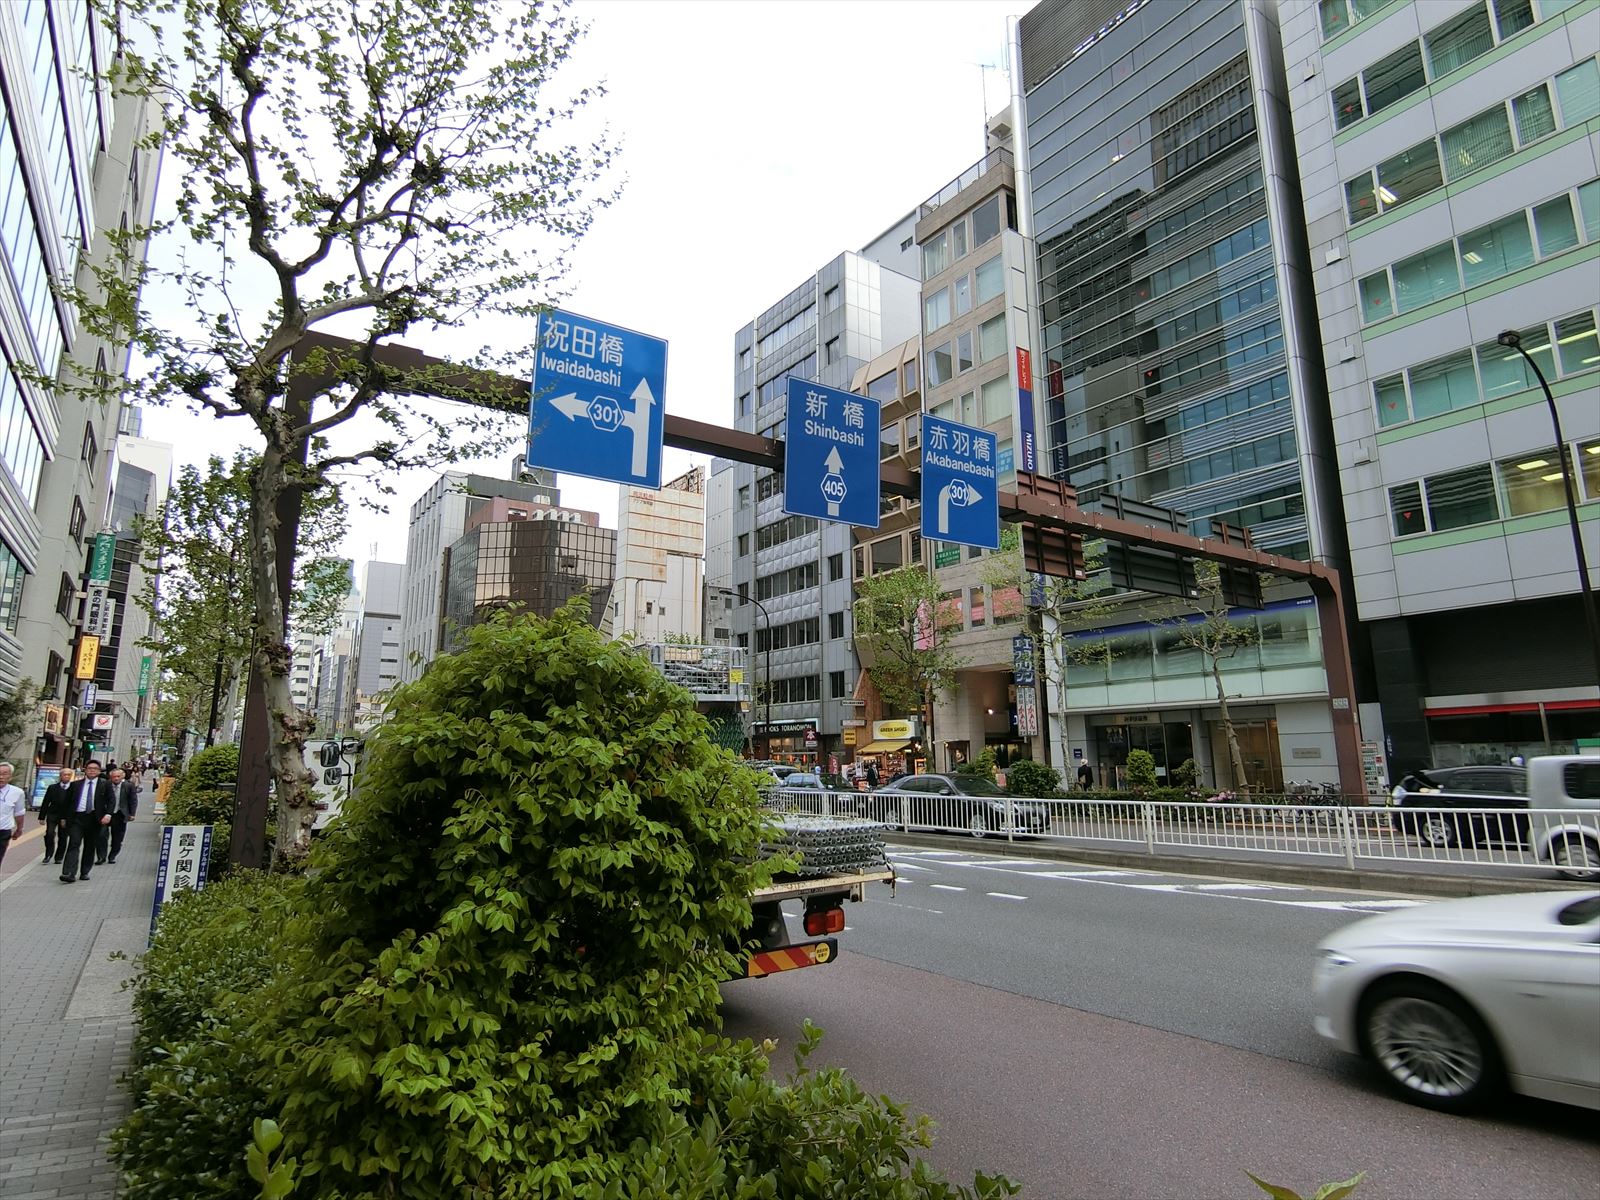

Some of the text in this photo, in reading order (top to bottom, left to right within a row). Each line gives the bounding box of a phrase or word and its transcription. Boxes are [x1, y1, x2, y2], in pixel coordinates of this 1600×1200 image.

[543, 317, 624, 368] 祝田橋
[541, 352, 622, 387] Iwaidabashi
[593, 404, 618, 424] 301
[805, 390, 865, 429] 新橋
[805, 420, 864, 446] Shinbashi
[930, 425, 990, 462] 赤羽橋
[925, 450, 995, 479] Akabanebashi
[1026, 432, 1034, 470] MIZUHO
[824, 480, 844, 496] 405
[951, 485, 967, 500] 301
